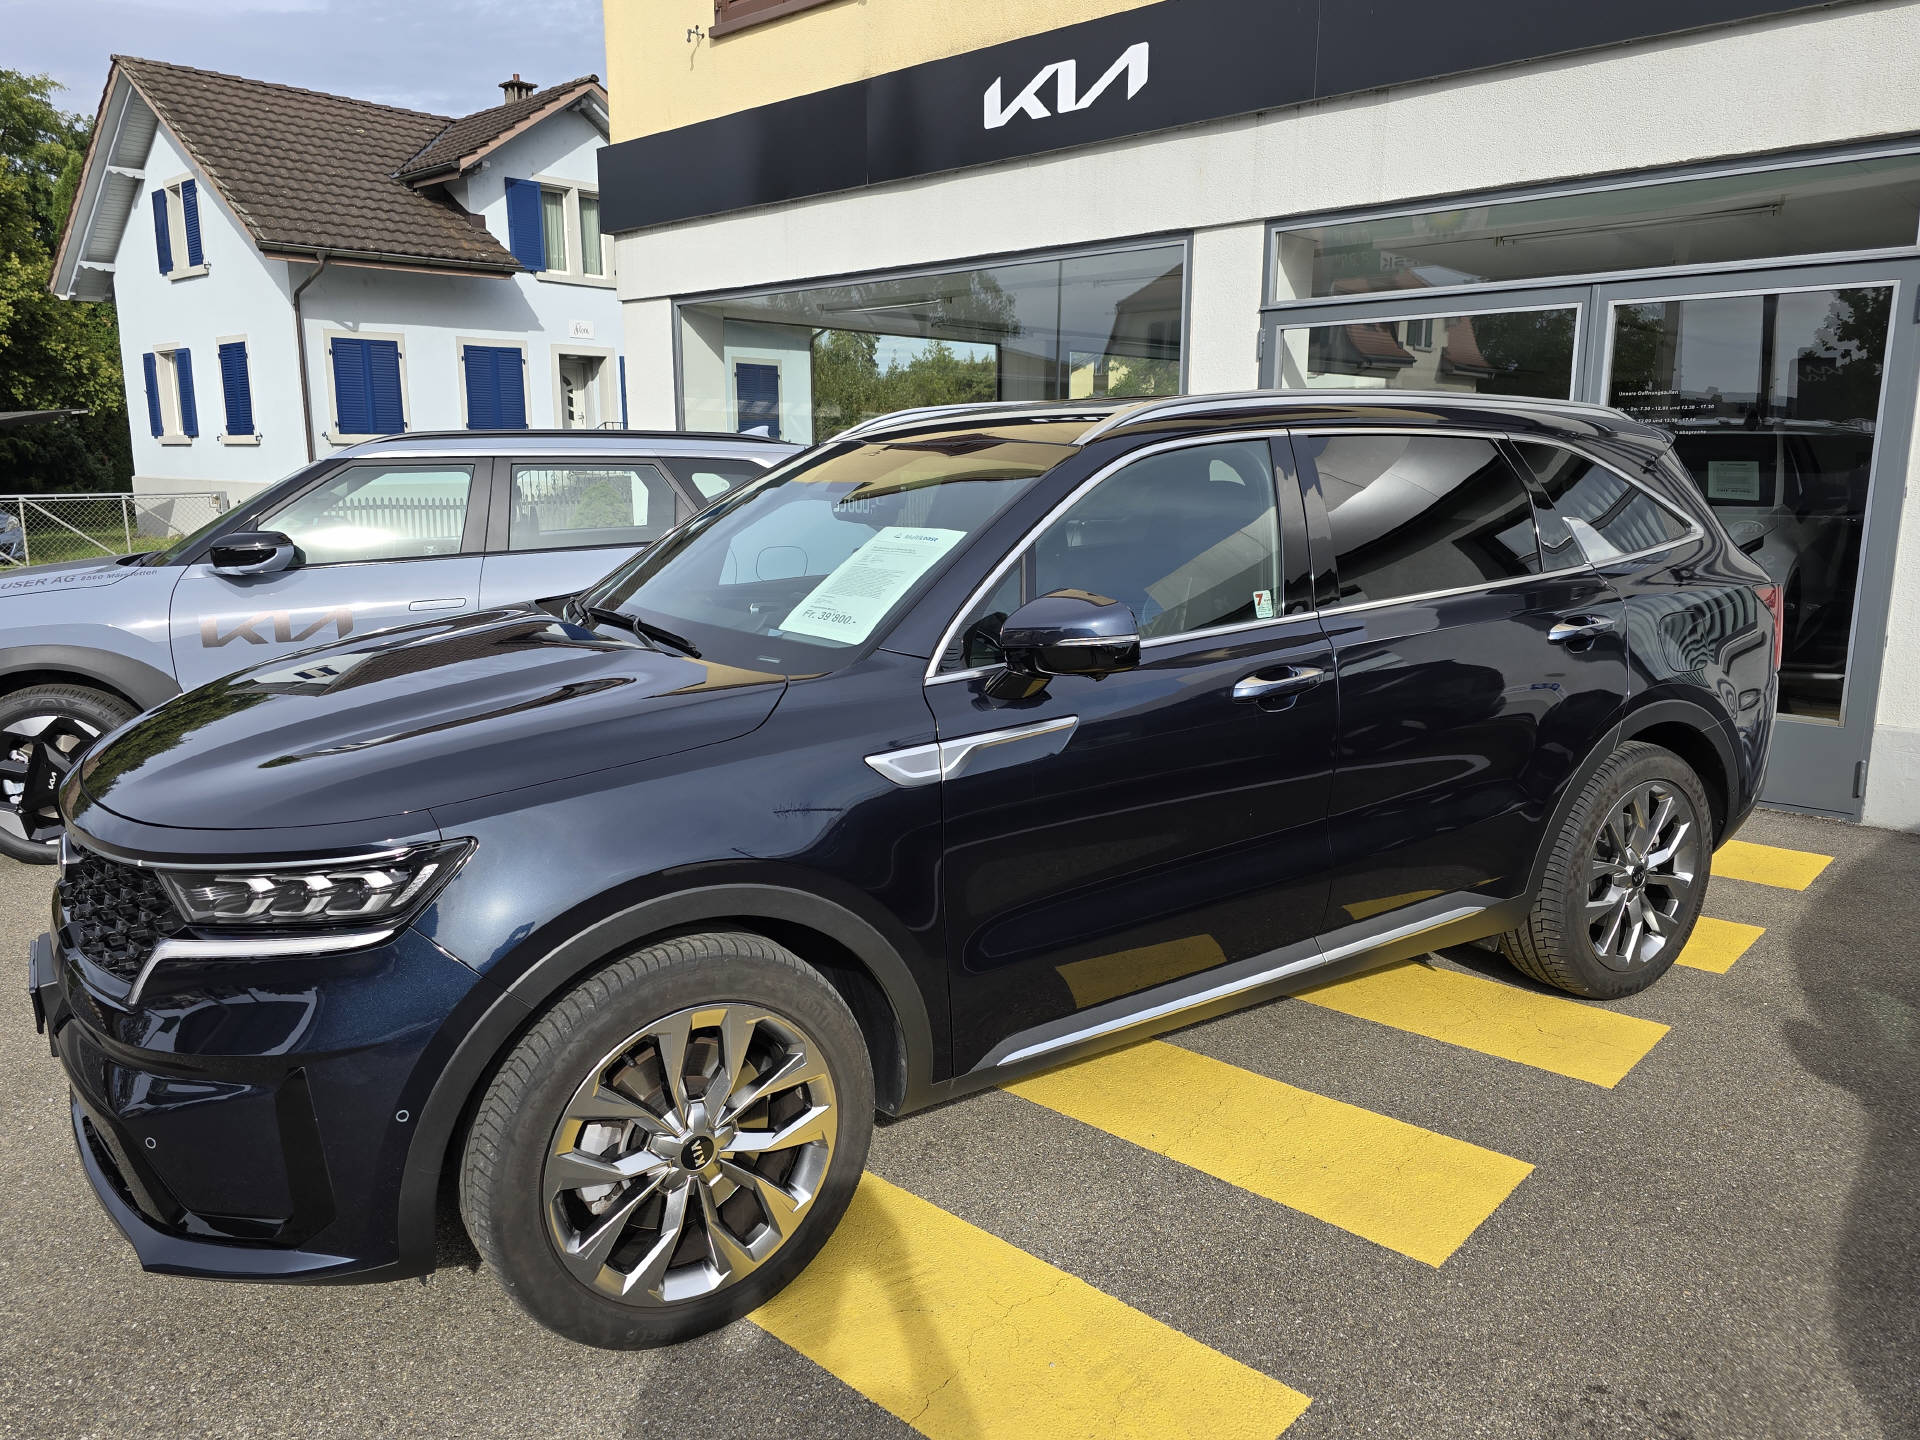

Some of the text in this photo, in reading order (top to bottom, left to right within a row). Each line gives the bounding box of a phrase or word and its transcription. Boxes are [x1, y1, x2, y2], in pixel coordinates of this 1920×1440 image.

[984, 41, 1149, 130] KIA
[1, 577, 48, 591] USER
[50, 575, 76, 585] AG
[79, 574, 104, 582] 8560
[1255, 593, 1264, 607] 7
[802, 609, 816, 619] Fr.
[200, 608, 354, 649] KIA
